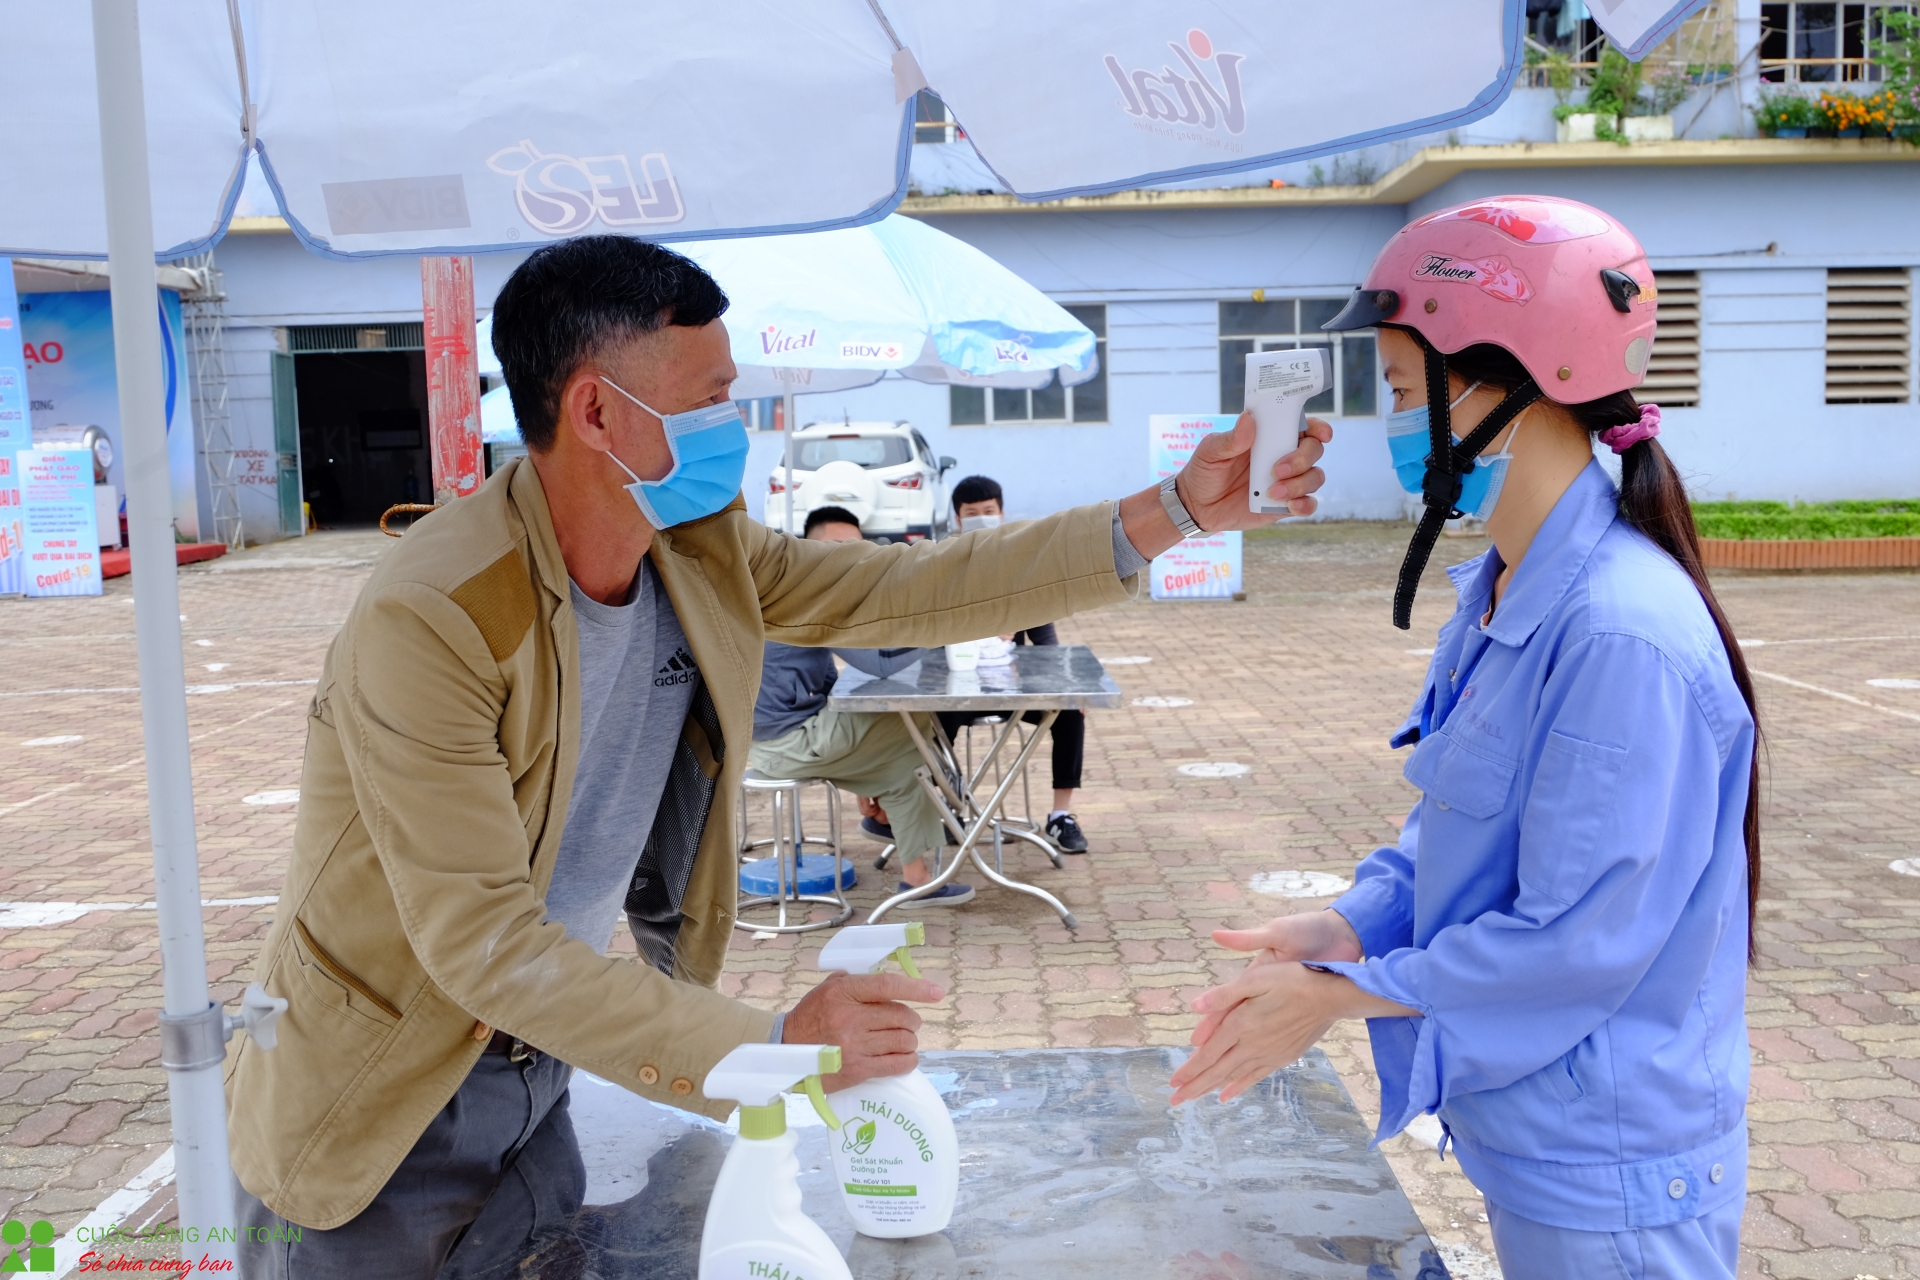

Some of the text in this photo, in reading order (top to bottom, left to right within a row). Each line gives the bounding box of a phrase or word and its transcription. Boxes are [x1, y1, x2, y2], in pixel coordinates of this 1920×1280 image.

[1415, 254, 1477, 280] Flower
[760, 326, 816, 355] Vital
[843, 346, 881, 357] BIDV
[24, 341, 64, 370] ẠO
[247, 459, 265, 472] XE
[36, 563, 91, 588] Covid-19
[1164, 561, 1231, 591] Covid-19
[860, 1099, 934, 1163] THÁI DƯƠNG
[851, 1156, 863, 1164] Gel
[865, 1157, 877, 1165] Sát
[877, 1166, 888, 1174] Da
